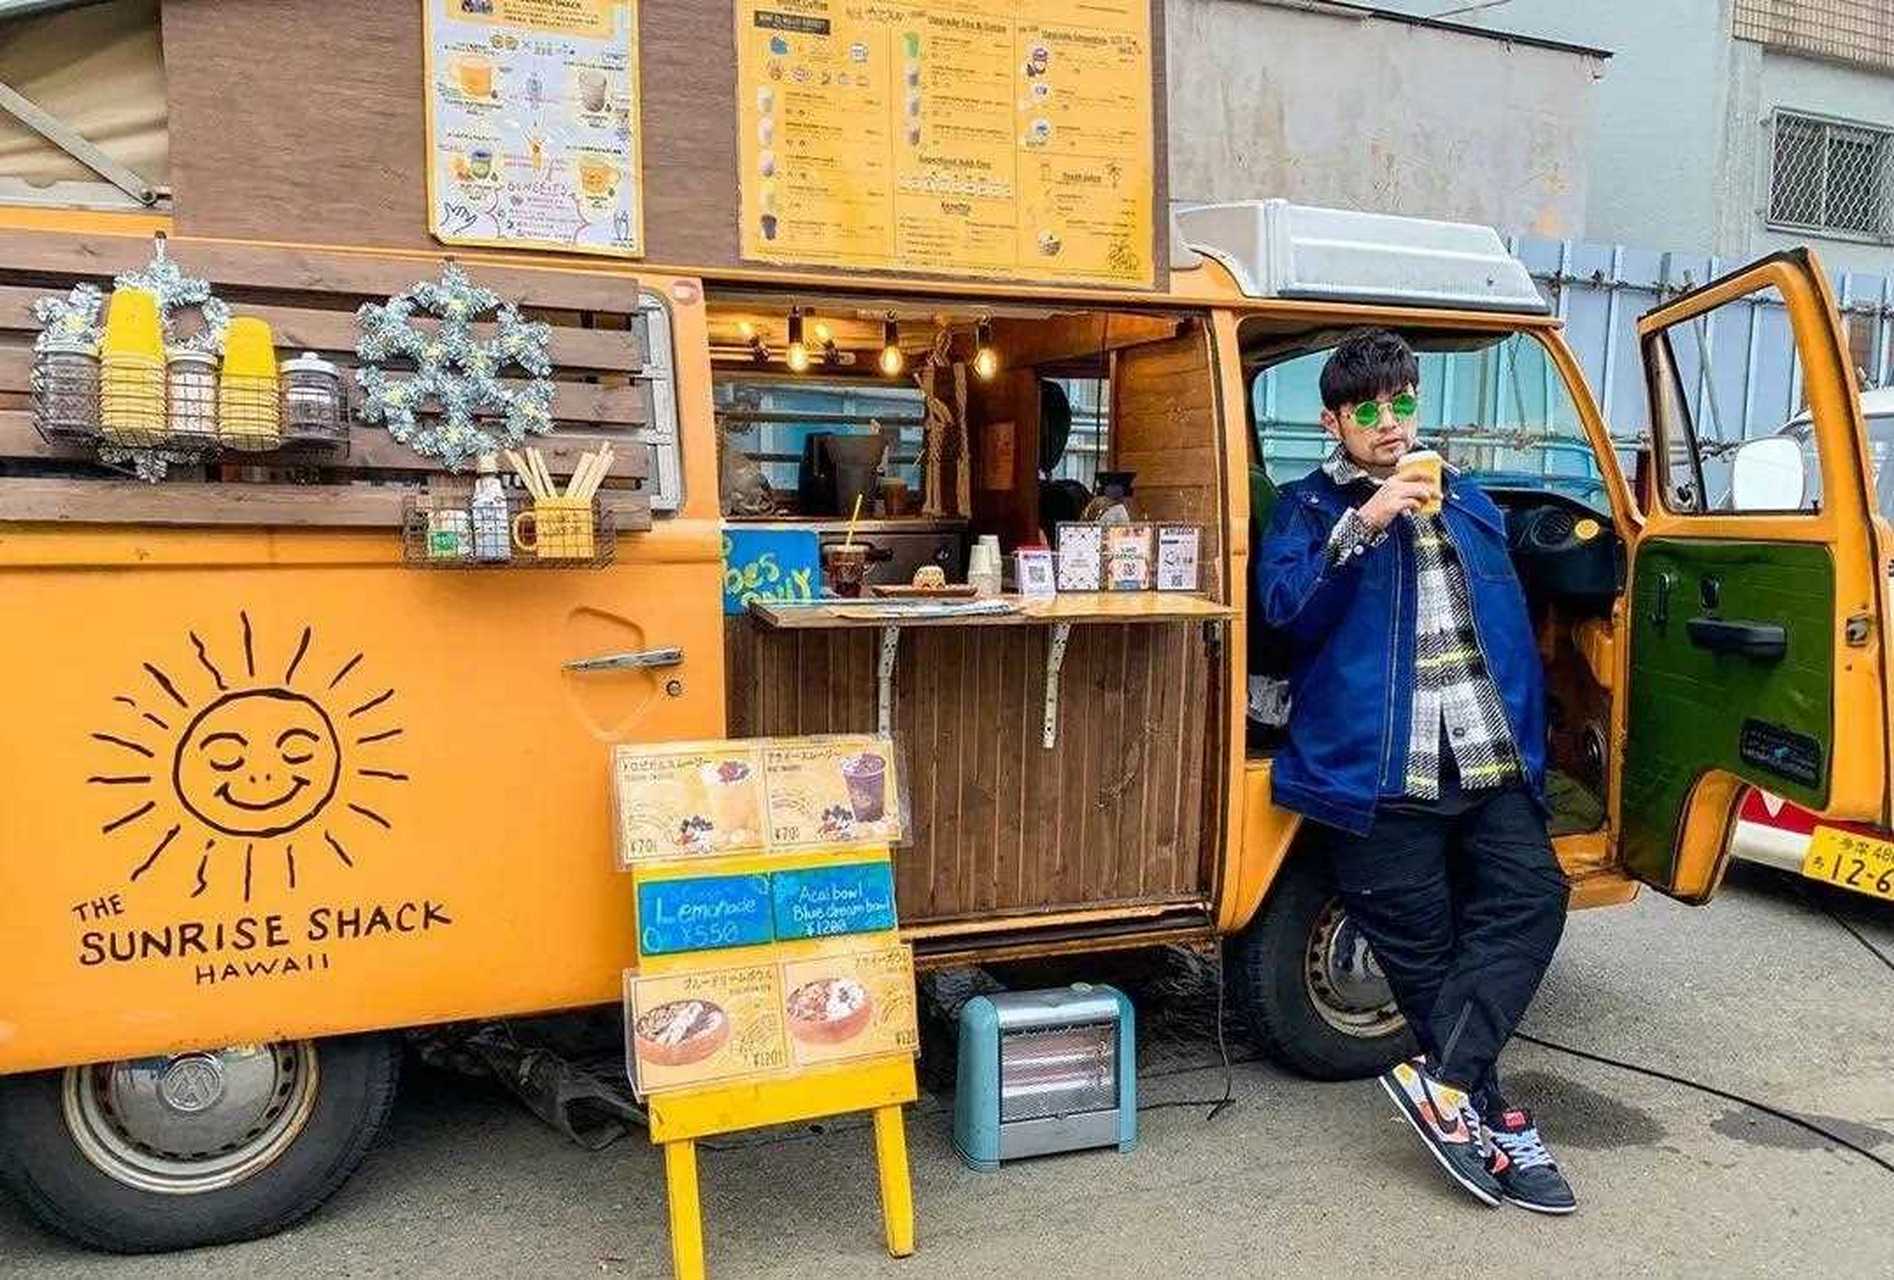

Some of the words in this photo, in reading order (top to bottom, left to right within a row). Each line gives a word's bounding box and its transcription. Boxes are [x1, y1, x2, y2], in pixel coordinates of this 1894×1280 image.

[831, 880, 863, 900] bowl
[72, 893, 125, 922] THE
[79, 914, 290, 966] SUNRISE
[307, 900, 453, 942] SHACK
[195, 953, 329, 985] HAWAII
